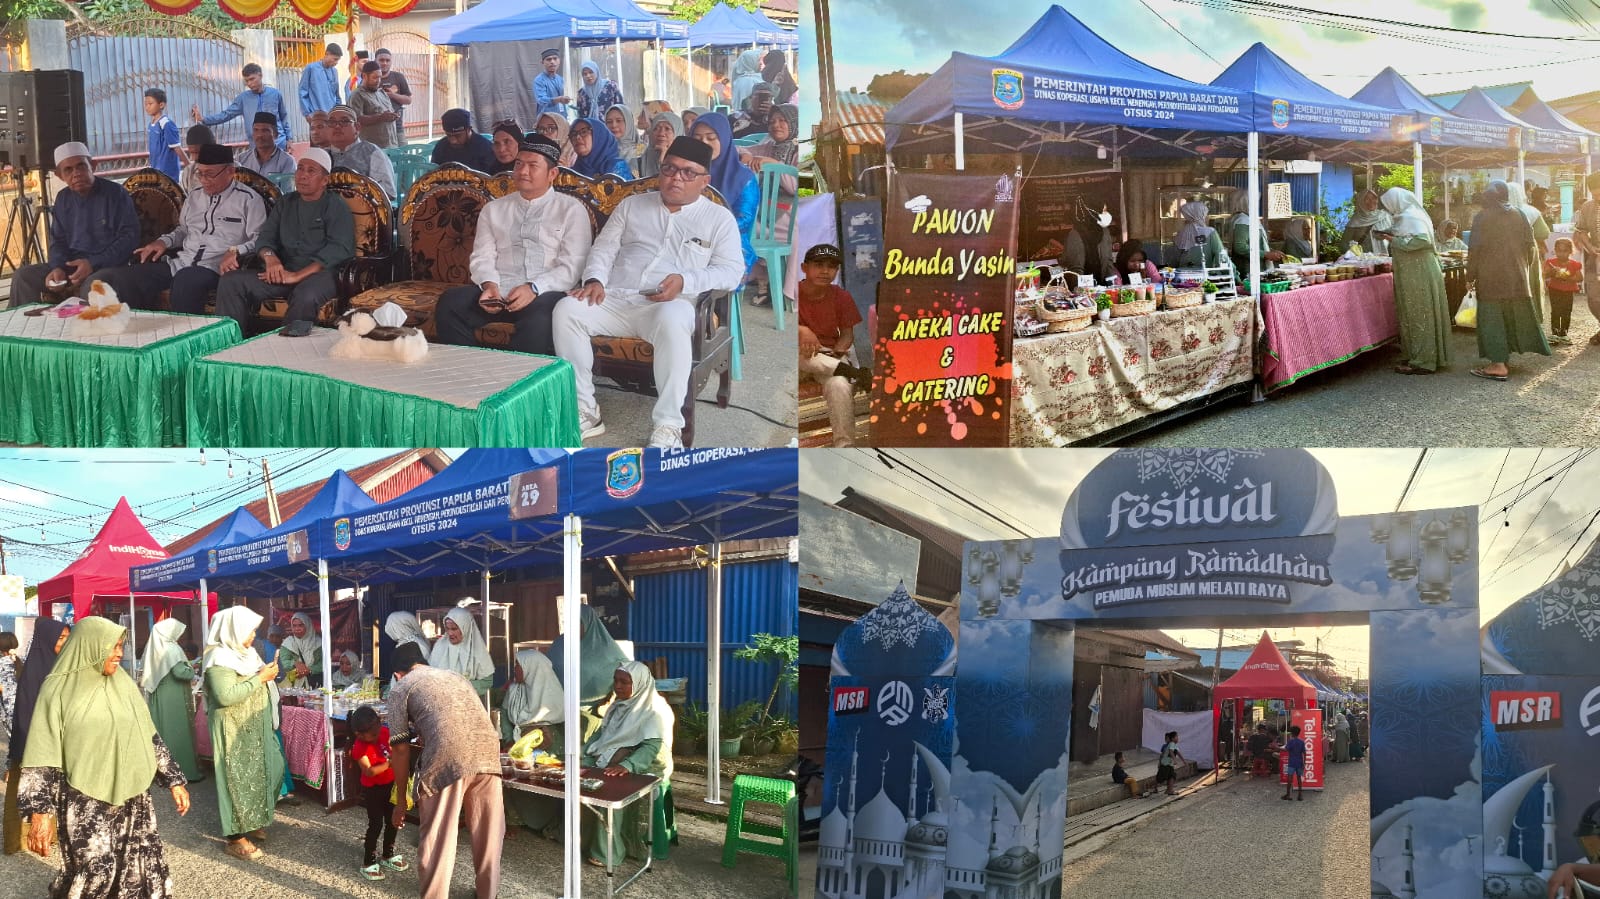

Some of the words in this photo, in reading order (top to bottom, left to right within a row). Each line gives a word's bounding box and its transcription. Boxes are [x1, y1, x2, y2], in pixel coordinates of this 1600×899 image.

[1033, 76, 1107, 95] PEMERINTAH
[1109, 85, 1157, 100] PROVINSI
[1159, 90, 1188, 102] PAPUA
[1190, 93, 1217, 104] BARAT
[1217, 95, 1239, 106] DAYA
[1034, 90, 1056, 100] DINAS
[1123, 108, 1153, 118] OTSUS
[1154, 110, 1175, 120] 2024
[912, 208, 995, 234] PAWON
[884, 247, 954, 280] Bunda
[957, 247, 1015, 281] Yasin
[892, 316, 953, 341] ANEKA
[958, 312, 1003, 336] CAKE
[940, 346, 954, 368] &
[901, 374, 990, 404] CATERING
[660, 454, 690, 472] DINAS
[354, 508, 399, 527] PEMERINTAH
[400, 498, 441, 518] PROVINSI
[442, 490, 473, 508] PAPUA
[475, 480, 510, 500] BARAT
[521, 489, 540, 507] 29
[411, 522, 436, 535] OTSUS
[437, 518, 458, 531] 2024
[1095, 584, 1143, 605] PEMUDA
[1147, 582, 1195, 598] MUSLIM
[1199, 581, 1245, 596] MELATI
[1248, 583, 1287, 599] RAYA
[836, 690, 865, 712] MSR
[1497, 696, 1552, 724] MSR
[1304, 717, 1318, 783] Telkomsel
